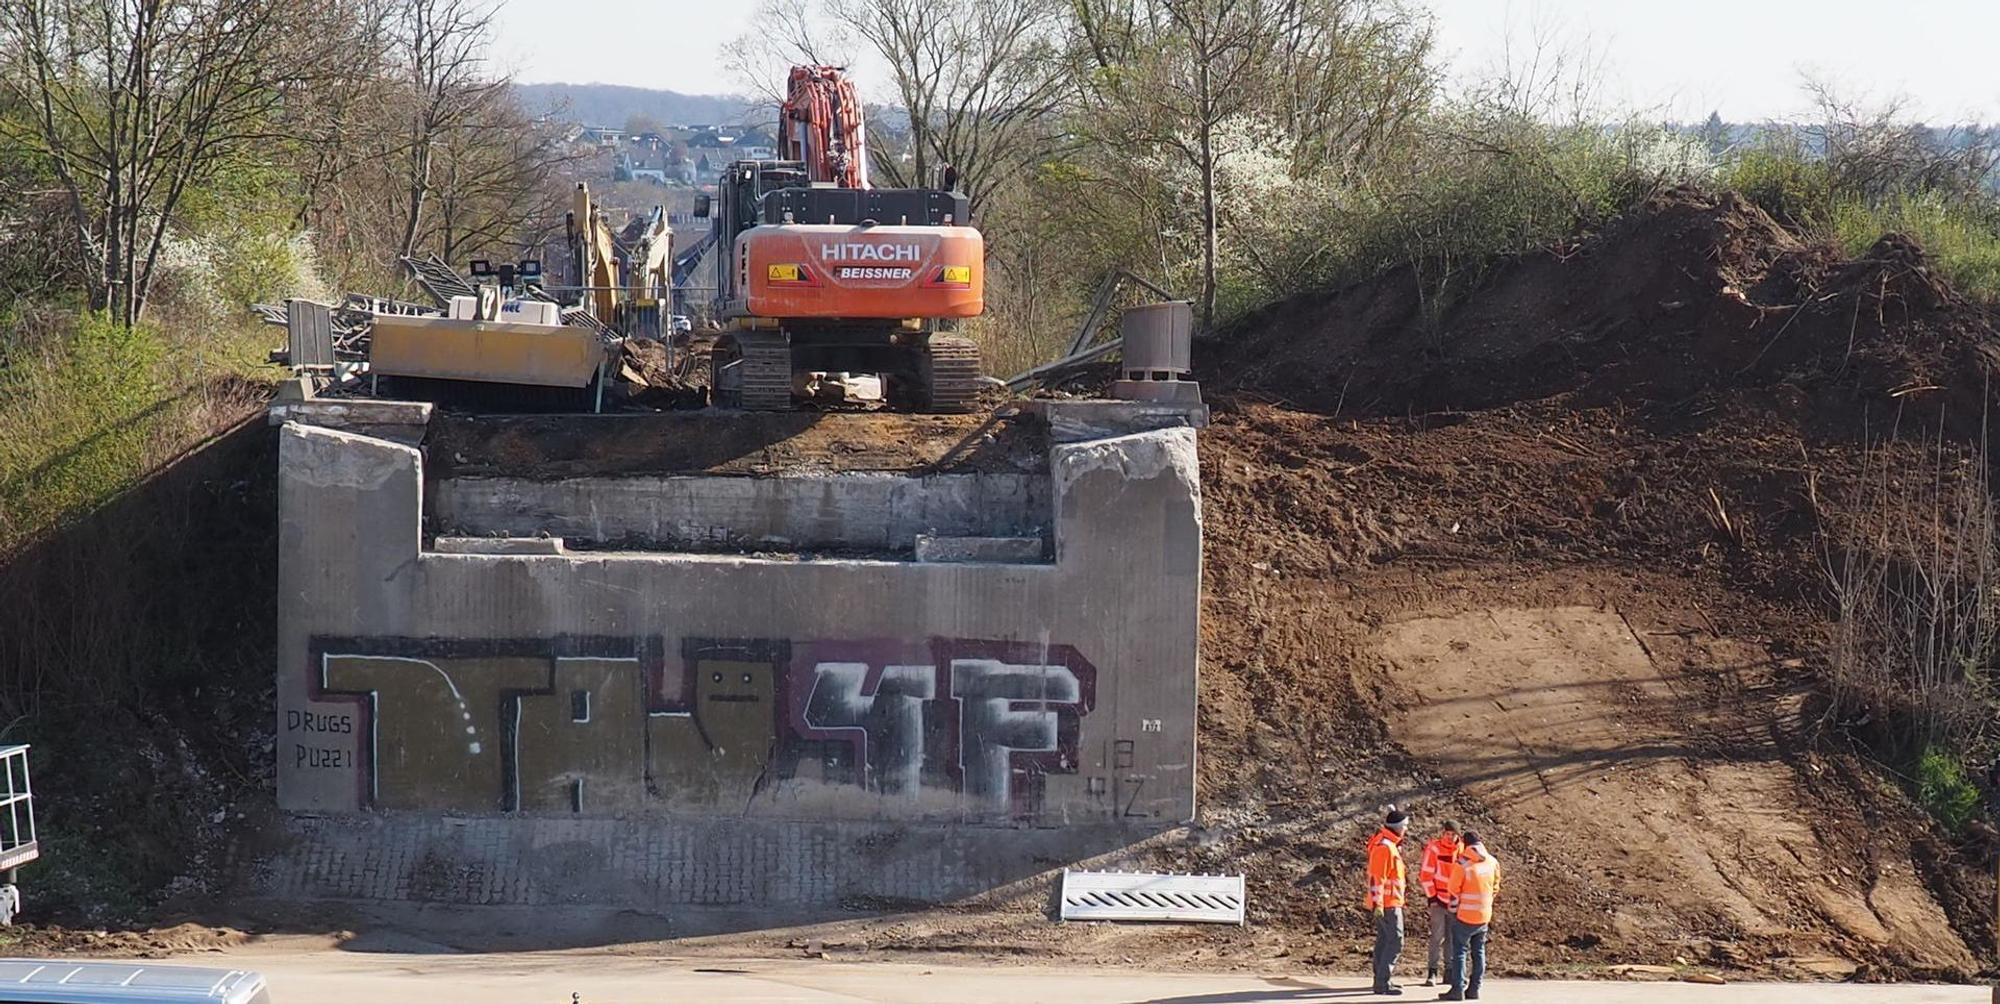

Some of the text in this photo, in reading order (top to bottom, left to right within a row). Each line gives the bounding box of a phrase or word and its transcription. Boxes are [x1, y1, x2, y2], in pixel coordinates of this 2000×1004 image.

[821, 243, 920, 261] HITACHI
[840, 267, 912, 280] BEISSNER
[287, 709, 352, 734] DRUGS
